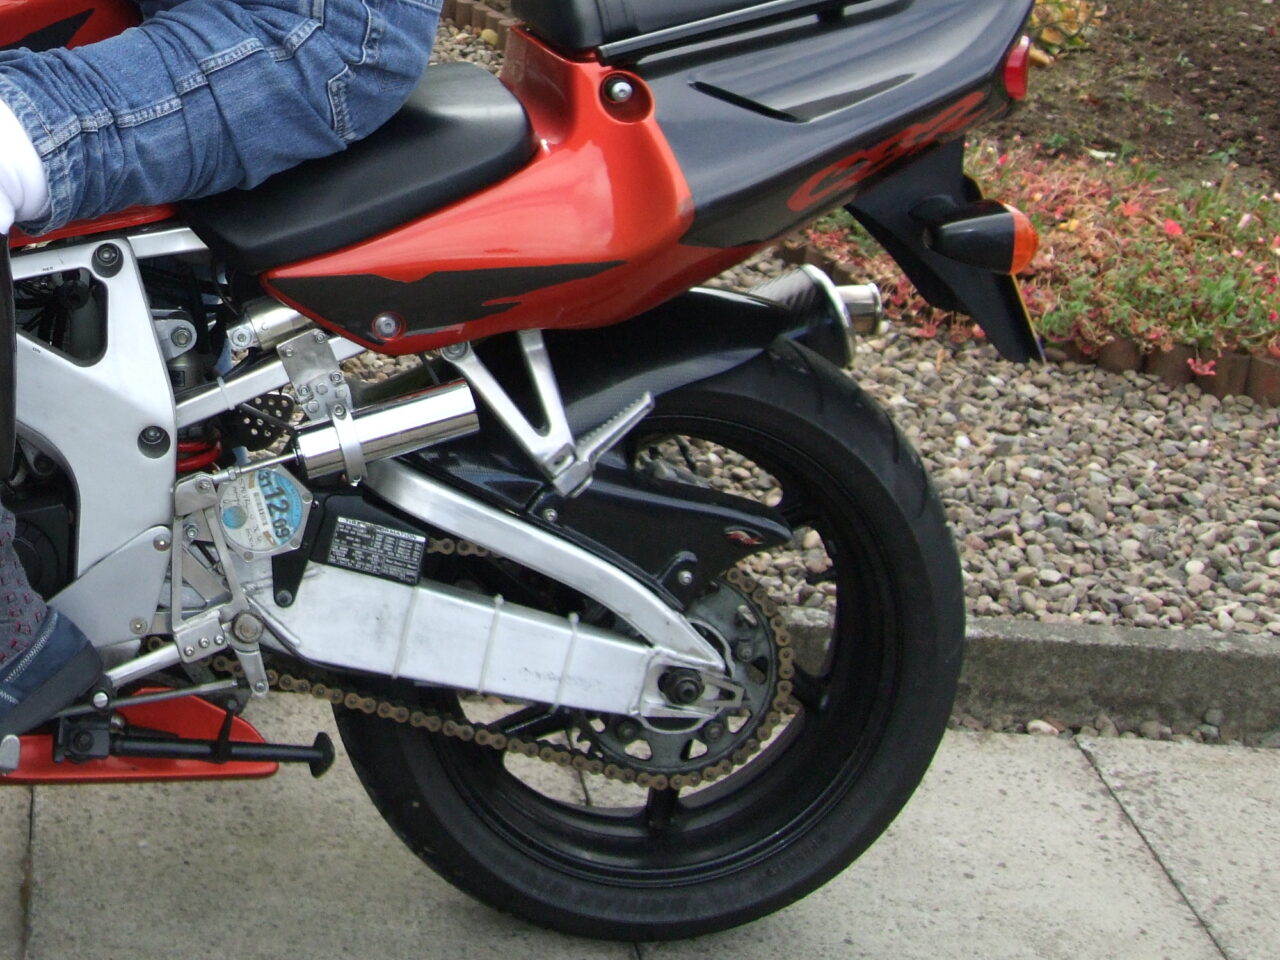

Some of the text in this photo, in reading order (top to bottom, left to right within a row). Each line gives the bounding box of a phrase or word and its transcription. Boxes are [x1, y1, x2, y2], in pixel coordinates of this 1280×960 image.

[258, 471, 272, 489] 31
[264, 486, 290, 518] 12
[272, 518, 291, 539] 09
